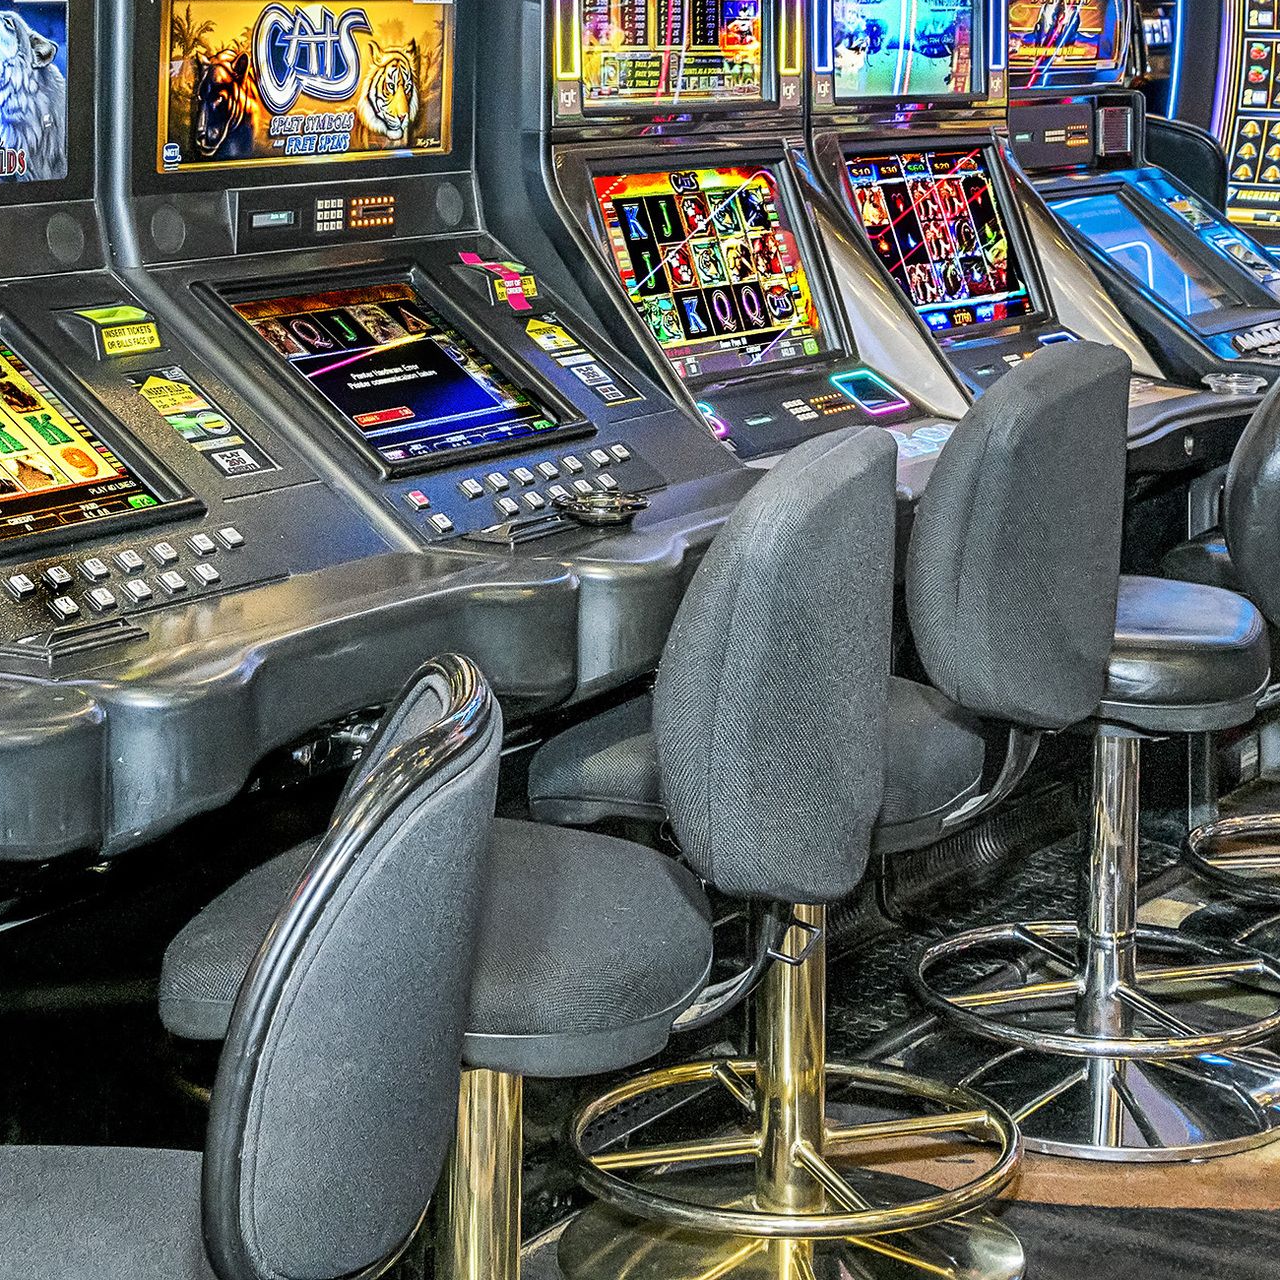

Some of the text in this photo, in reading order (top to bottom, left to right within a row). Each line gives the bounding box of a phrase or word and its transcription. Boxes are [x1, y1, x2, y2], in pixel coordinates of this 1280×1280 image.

[252, 2, 372, 114] CATS
[783, 83, 796, 99] igt
[817, 81, 829, 96] igt
[560, 89, 576, 106] igt
[270, 112, 355, 135] SPLIT SYMBOLS
[285, 135, 316, 154] FREE
[319, 133, 351, 152] SPINS
[851, 168, 870, 177] $10
[880, 166, 898, 174] $30
[104, 326, 152, 338] INSERT TICKETS
[108, 340, 116, 348] OR
[133, 337, 148, 346] FACE
